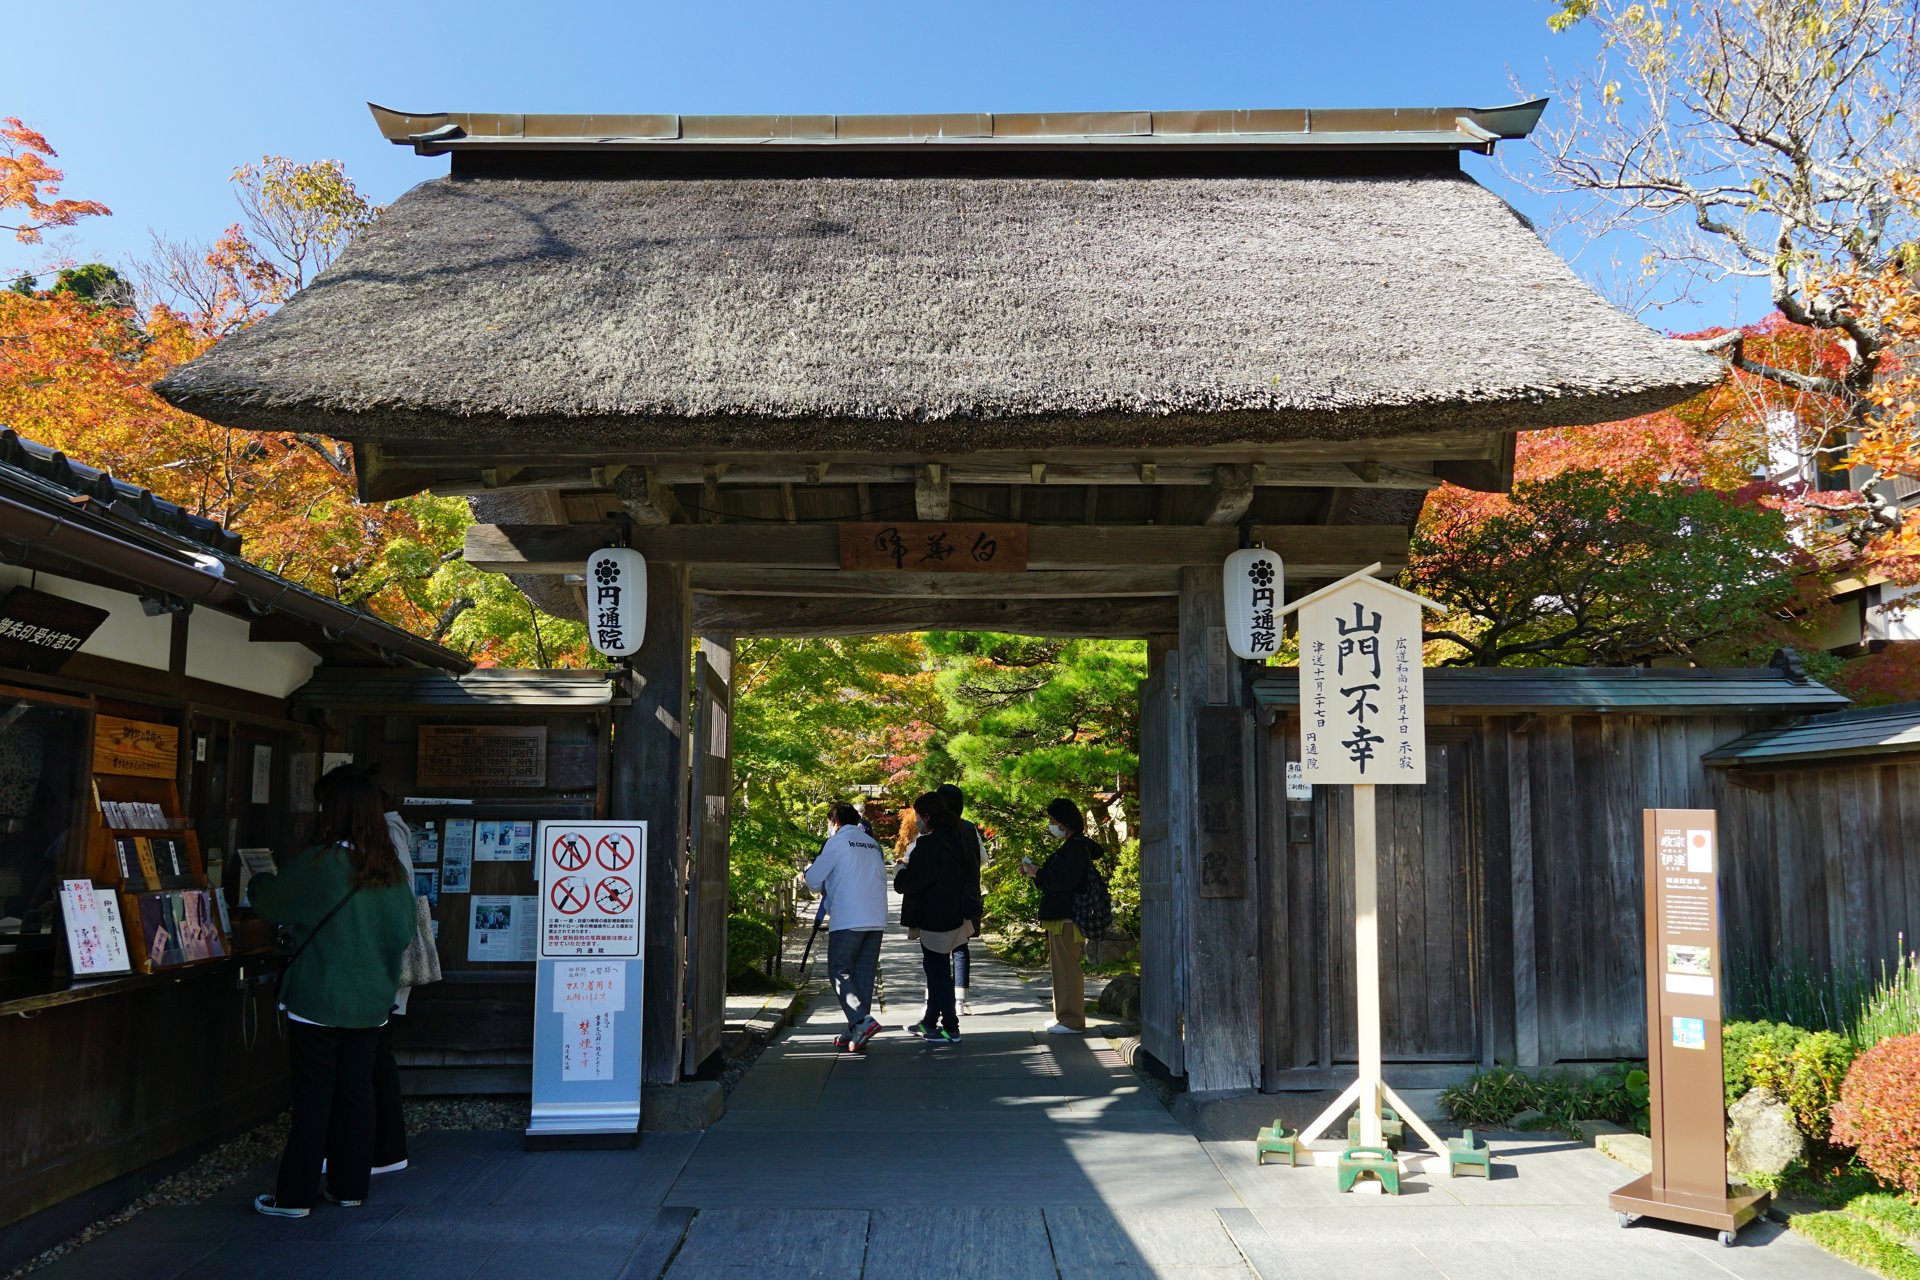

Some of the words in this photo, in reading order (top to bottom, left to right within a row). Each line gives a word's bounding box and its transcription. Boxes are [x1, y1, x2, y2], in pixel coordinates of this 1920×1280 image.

[597, 586, 625, 649] 円通院
[1251, 588, 1276, 653] 円通院
[1312, 640, 1326, 727] 津送十一月二十七日
[1335, 602, 1384, 774] 山門不幸
[1306, 732, 1319, 769] 円通院
